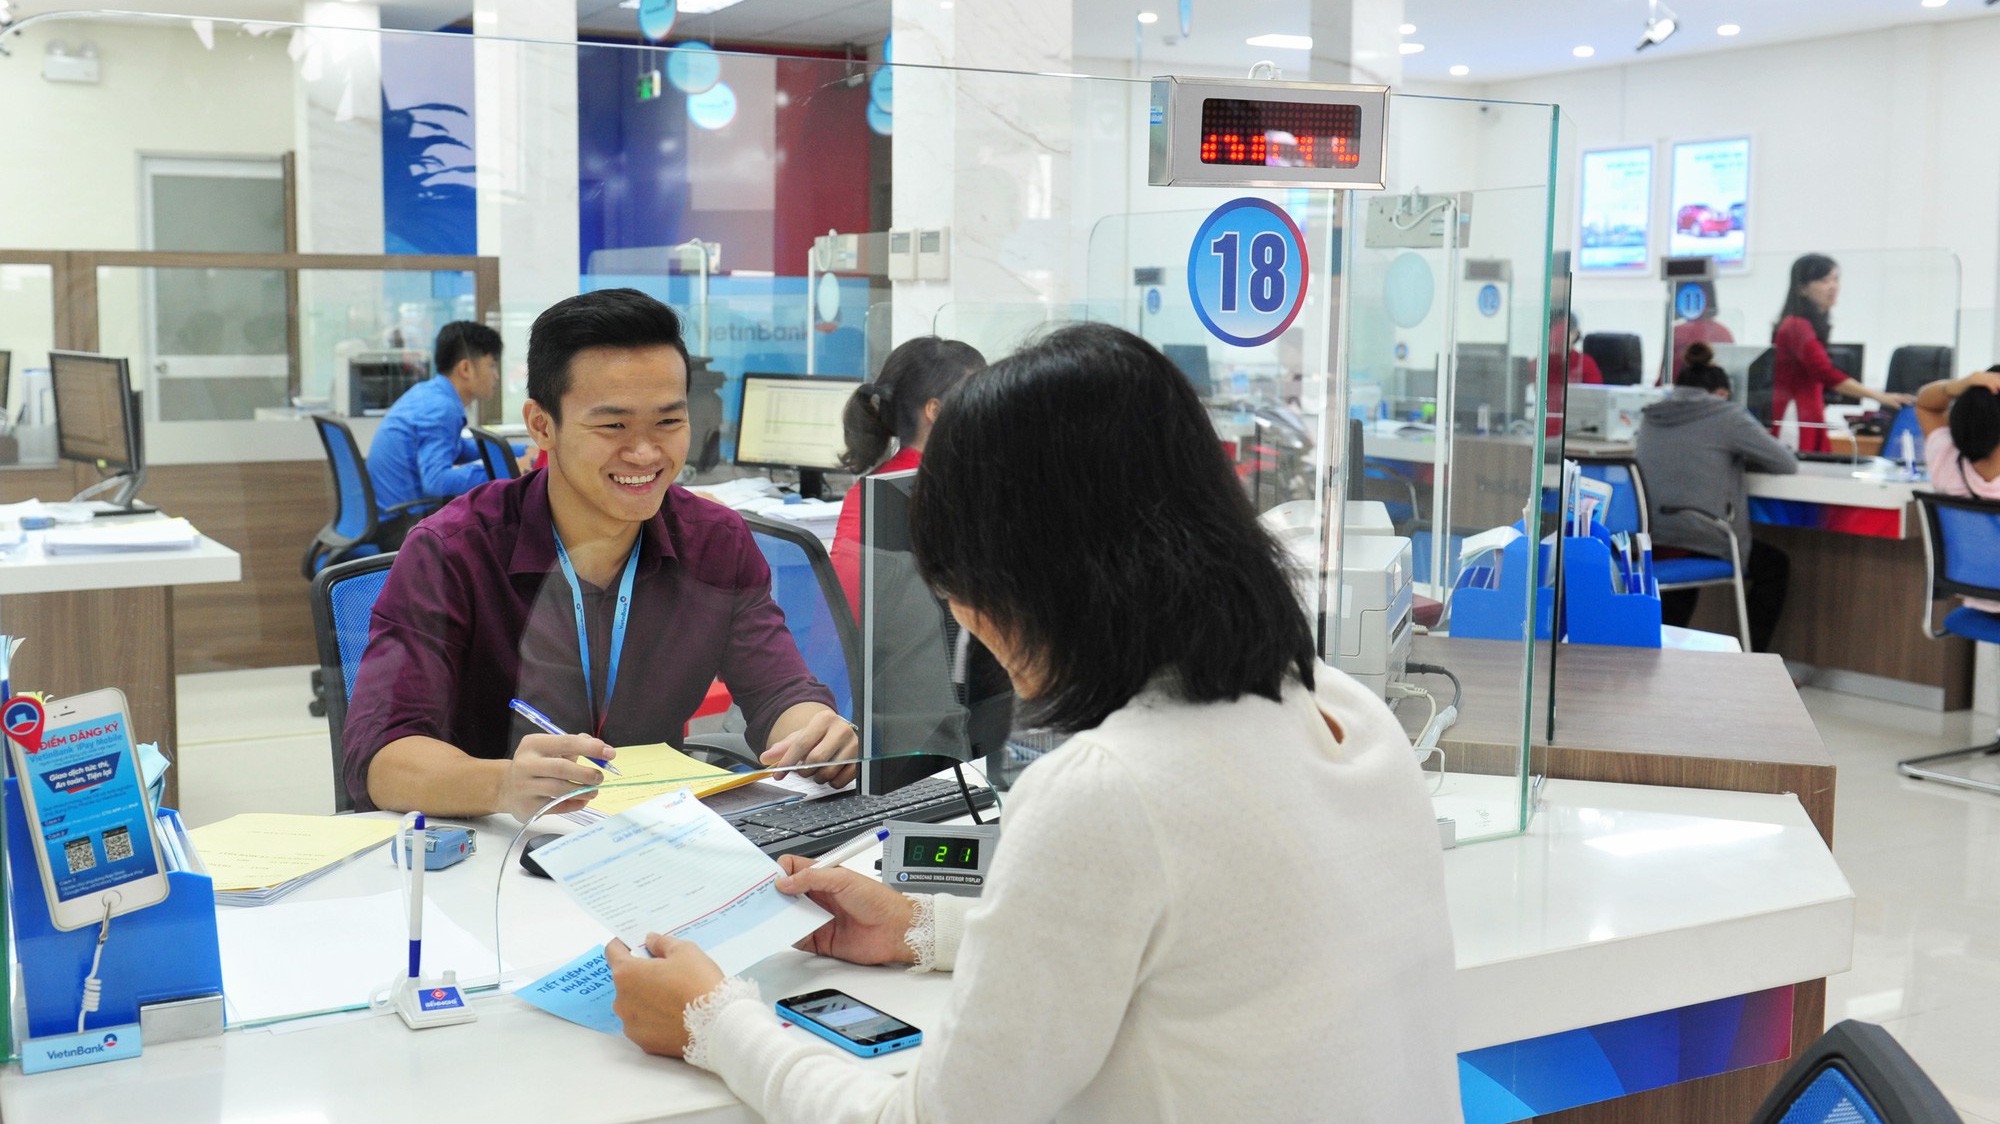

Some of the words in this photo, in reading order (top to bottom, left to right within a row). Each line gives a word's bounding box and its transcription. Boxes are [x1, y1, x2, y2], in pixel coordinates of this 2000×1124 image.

[1210, 230, 1288, 314] 18
[55, 781, 66, 789] An
[964, 876, 981, 884] DISPLAY
[536, 980, 560, 993] TIẾT
[559, 967, 585, 983] KIỆM
[583, 954, 606, 969] IPAY
[561, 976, 592, 993] NHẬN
[46, 1044, 104, 1060] VietinBank
